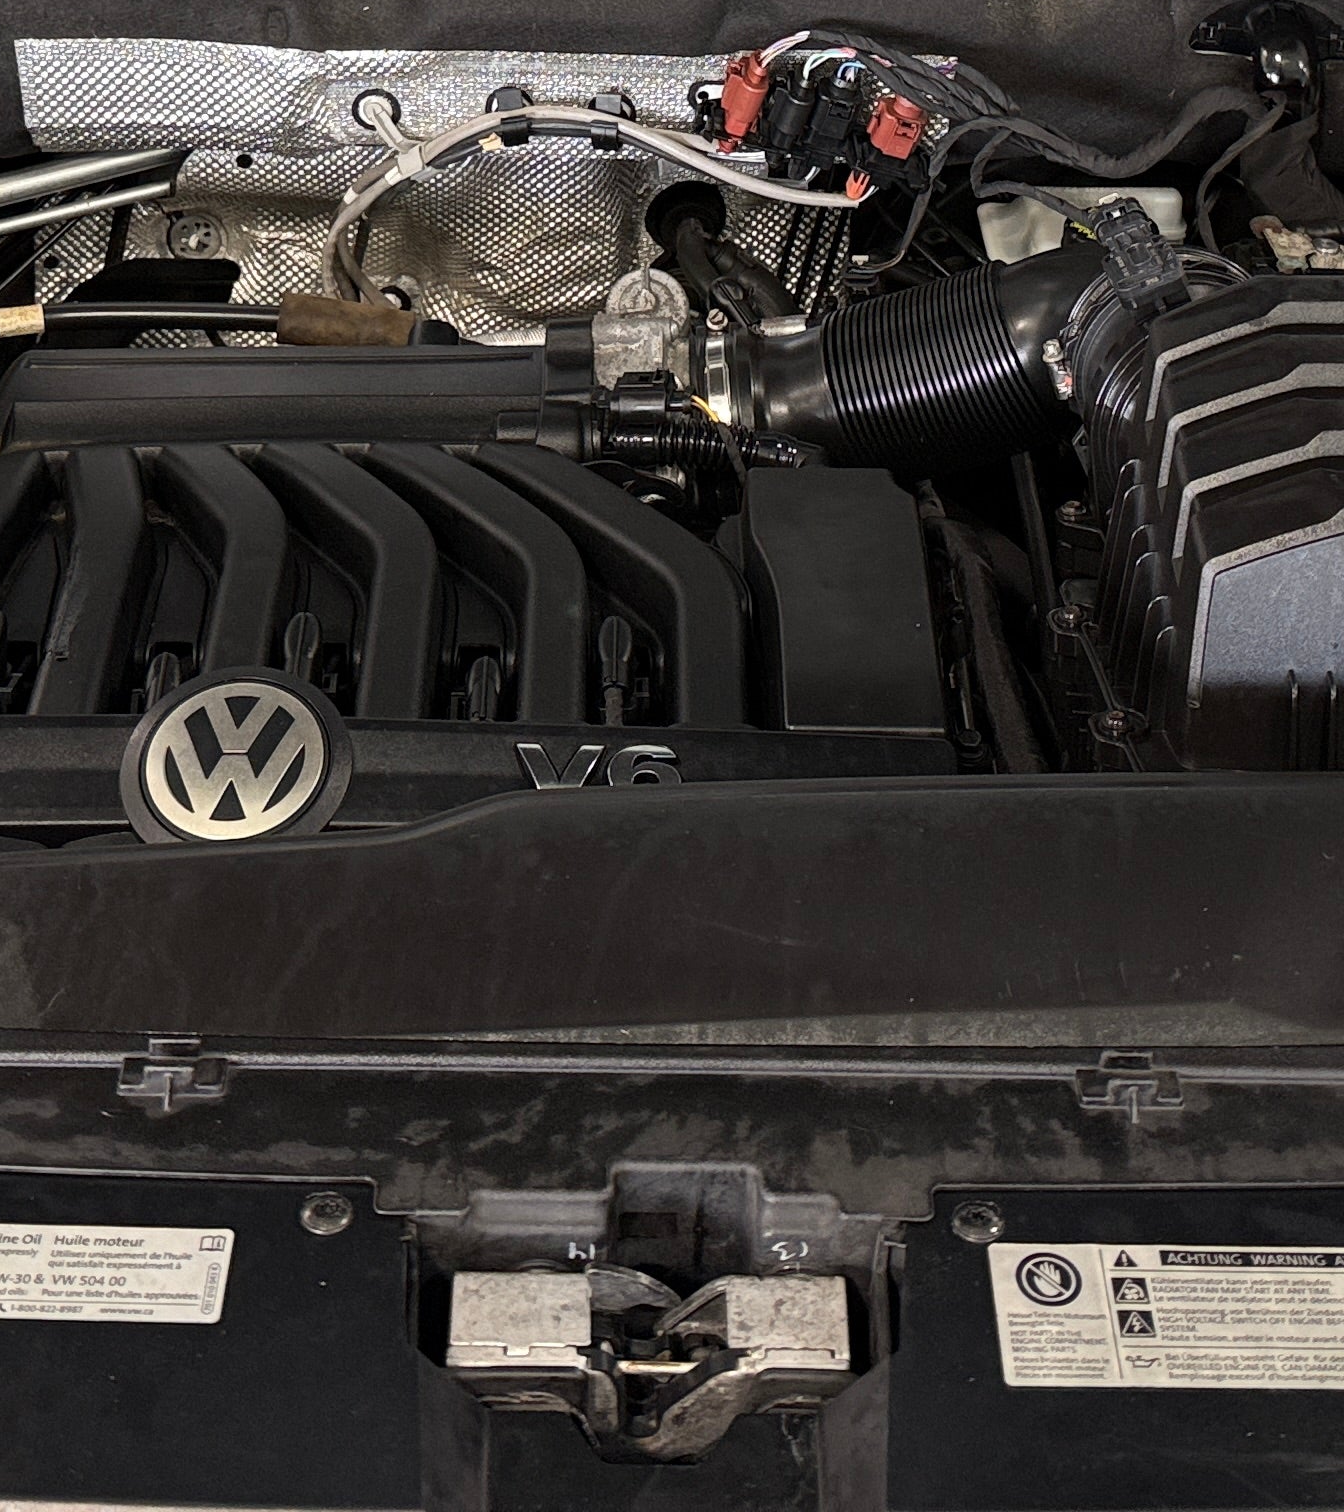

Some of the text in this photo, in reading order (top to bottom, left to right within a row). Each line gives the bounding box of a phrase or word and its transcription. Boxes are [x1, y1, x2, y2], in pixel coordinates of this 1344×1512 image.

[514, 743, 683, 791] V6
[22, 1233, 43, 1245] Oil
[53, 1235, 146, 1248] Huile moteur
[50, 1250, 193, 1262] Utilisez uniquement de l'huile
[1166, 1252, 1244, 1266] ACHTUNG
[1251, 1254, 1328, 1267] WARNING
[47, 1260, 65, 1269] qui
[66, 1260, 105, 1269] satisfait
[33, 1273, 46, 1285] &
[52, 1274, 77, 1286] VW
[78, 1275, 106, 1287] 504
[108, 1276, 127, 1287] 00
[41, 1288, 64, 1298] Pour
[65, 1290, 85, 1299] une
[85, 1289, 105, 1299] liste
[106, 1289, 143, 1299] d'huiles
[1200, 1286, 1219, 1294] FAN
[1220, 1286, 1242, 1294] MAY
[1243, 1286, 1272, 1295] START
[1287, 1287, 1306, 1295] ANY
[1154, 1295, 1165, 1303] Le
[1217, 1295, 1230, 1304] de
[1297, 1297, 1308, 1305] se
[1157, 1316, 1183, 1324] HIGH
[1230, 1317, 1268, 1325] SWITCH
[1269, 1317, 1286, 1325] OFF
[1288, 1317, 1323, 1325] ENGINE
[1166, 1362, 1223, 1371] OVERFILLED
[1224, 1363, 1259, 1371] ENGINE
[1261, 1363, 1277, 1372] OIL
[1281, 1364, 1302, 1372] CAN
